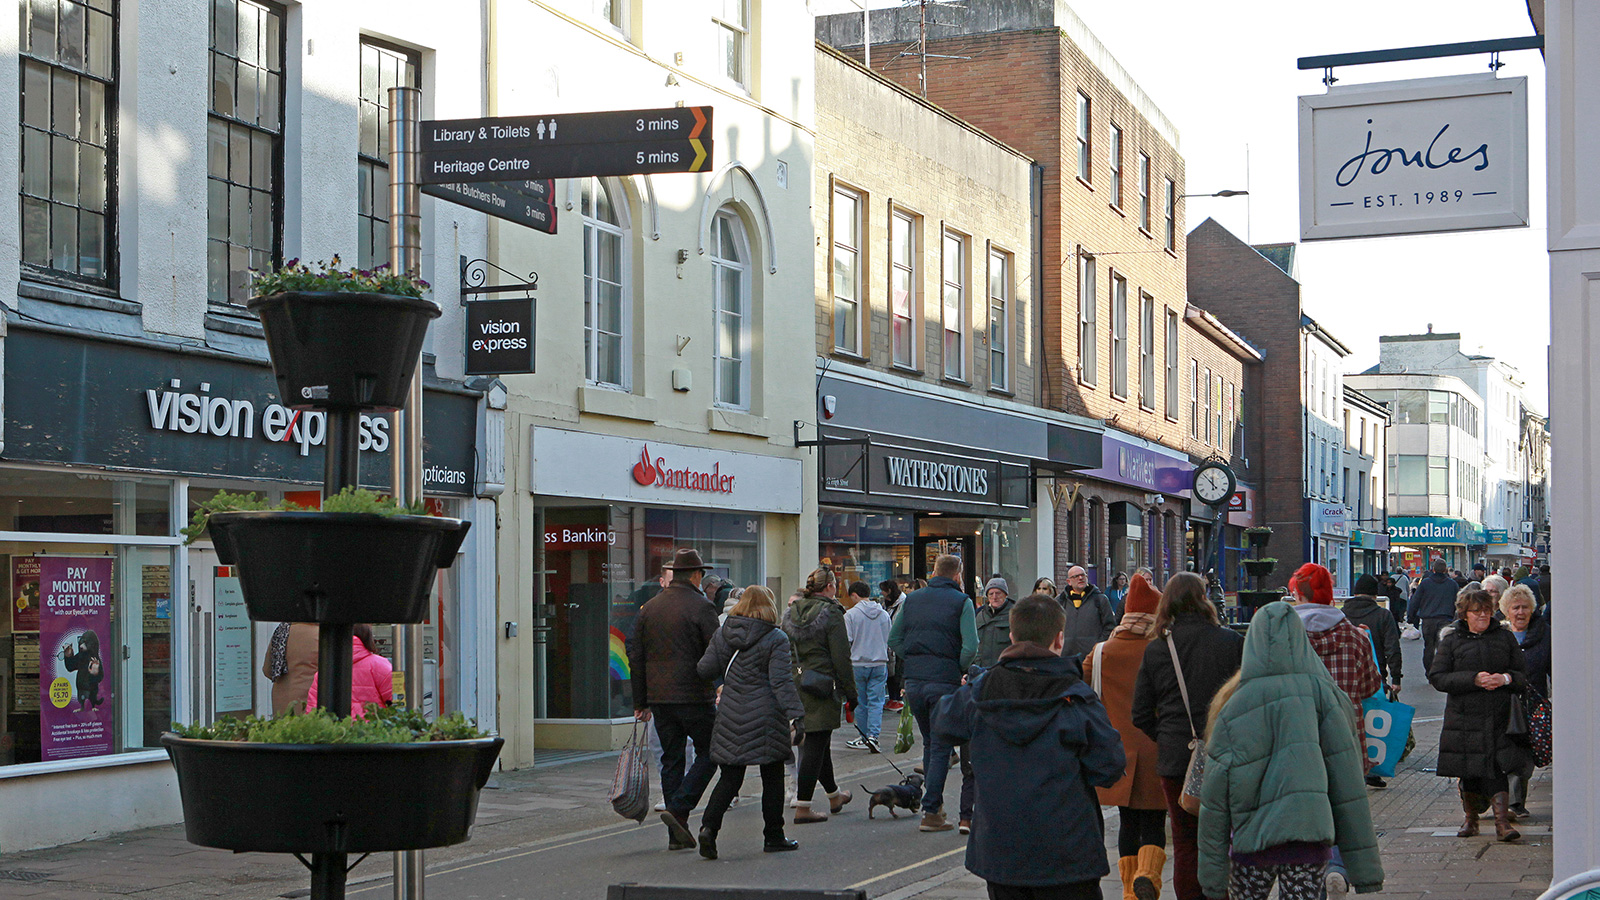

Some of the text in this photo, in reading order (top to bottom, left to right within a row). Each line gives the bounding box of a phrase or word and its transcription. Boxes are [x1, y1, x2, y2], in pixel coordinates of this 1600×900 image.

[635, 117, 679, 131] 3 mins
[433, 125, 530, 143] Library & Toilets
[635, 150, 680, 164] 5 mins
[1335, 118, 1489, 187] joules
[433, 158, 530, 175] Heritage Centre
[529, 180, 544, 194] mins
[456, 183, 461, 193] &
[462, 183, 491, 204] Butchers
[491, 193, 507, 208] Row
[1363, 189, 1463, 208] EST. 1989
[525, 205, 546, 222] 3 mins
[480, 319, 520, 334] vision
[472, 338, 527, 353] express
[146, 378, 389, 456] vision expss
[655, 456, 735, 494] Santander
[887, 455, 988, 496] WATERSTONES
[1043, 481, 1084, 511] W
[1322, 507, 1344, 516] iCrack
[562, 527, 616, 546] Banking
[1387, 522, 1456, 538] oundland
[67, 567, 88, 579] PAY
[52, 580, 101, 593] MONTHLY
[47, 594, 106, 607] & GET MORE
[156, 600, 168, 608] Open
[53, 691, 69, 699] £5.70
